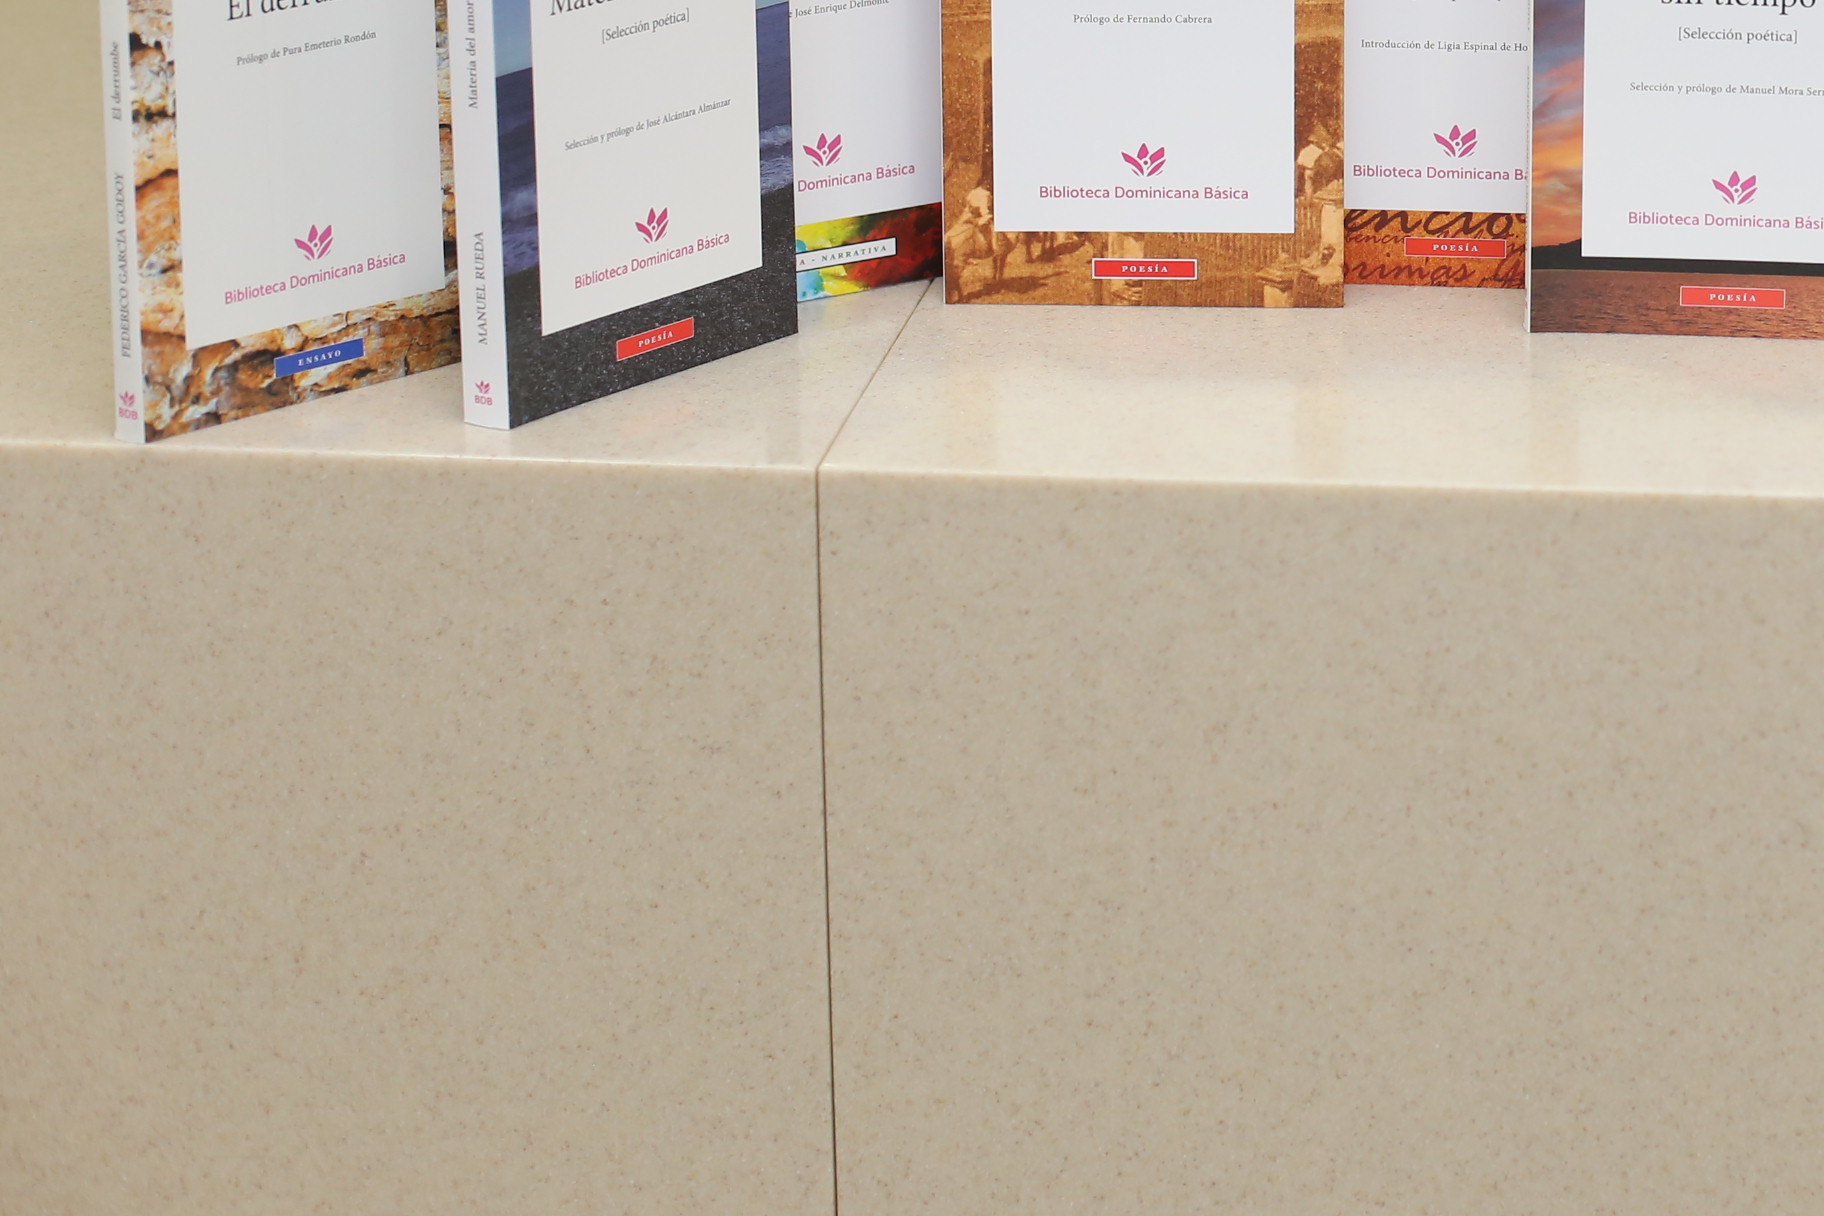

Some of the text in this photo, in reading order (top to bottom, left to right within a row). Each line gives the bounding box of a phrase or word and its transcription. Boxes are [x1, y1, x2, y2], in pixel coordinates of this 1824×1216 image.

[794, 6, 811, 18] José
[814, 3, 847, 14] Enrique
[602, 7, 689, 44] [Selección poética]
[1074, 13, 1212, 25] Prólogo de Fernando Cabrera
[1678, 26, 1797, 44] [Selección poética]
[236, 30, 376, 66] Prólogo de Pura Emeterio Rondón
[1360, 38, 1420, 49] Introducción
[1424, 39, 1434, 50] de
[1438, 40, 1460, 52] Ligia
[1464, 41, 1497, 53] Espinal
[1500, 41, 1511, 52] de
[1630, 81, 1674, 92] Selección
[1686, 83, 1722, 95] prólogo
[1726, 83, 1736, 94] de
[1740, 84, 1775, 95] Manuel
[1778, 85, 1803, 96] Mora
[798, 163, 915, 192] Dominicana Básica
[1352, 165, 1421, 178] Biblioteca
[1426, 167, 1509, 180] Dominicana
[1040, 185, 1248, 200] Biblioteca Dominicana Básica
[1628, 211, 1699, 226] Biblioteca
[1704, 213, 1790, 228] Dominicana
[822, 245, 886, 261] NARRATIVA
[1432, 242, 1478, 252] POESÍA
[574, 233, 731, 289] Biblioteca Dominicana Básica
[1122, 263, 1168, 273] POESÍA
[224, 253, 405, 304] Biblioteca Dominicana Básica
[1710, 291, 1756, 303] POESÍA
[638, 330, 674, 348] POESÍA
[298, 350, 341, 366] ENSAYO
